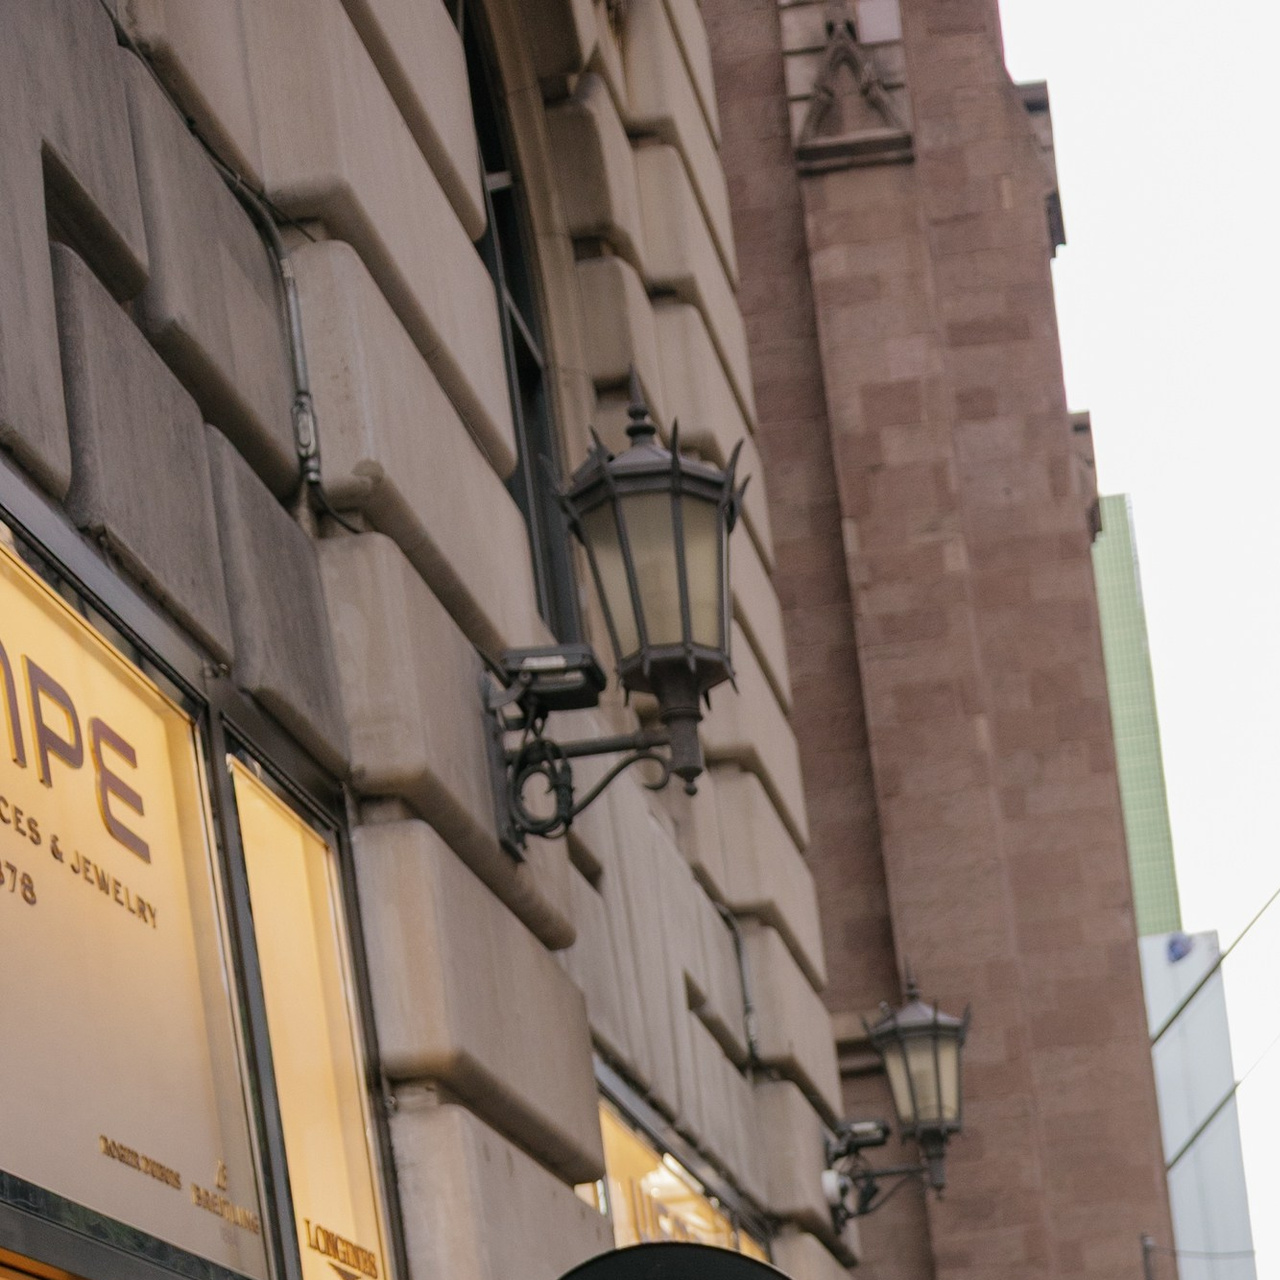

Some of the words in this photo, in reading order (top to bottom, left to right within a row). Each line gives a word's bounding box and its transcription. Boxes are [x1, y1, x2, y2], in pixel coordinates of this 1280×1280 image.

[0, 859, 36, 906] 78
[50, 834, 64, 863] &
[70, 851, 158, 929] JEWELRY
[304, 1218, 378, 1279] LONGINES
